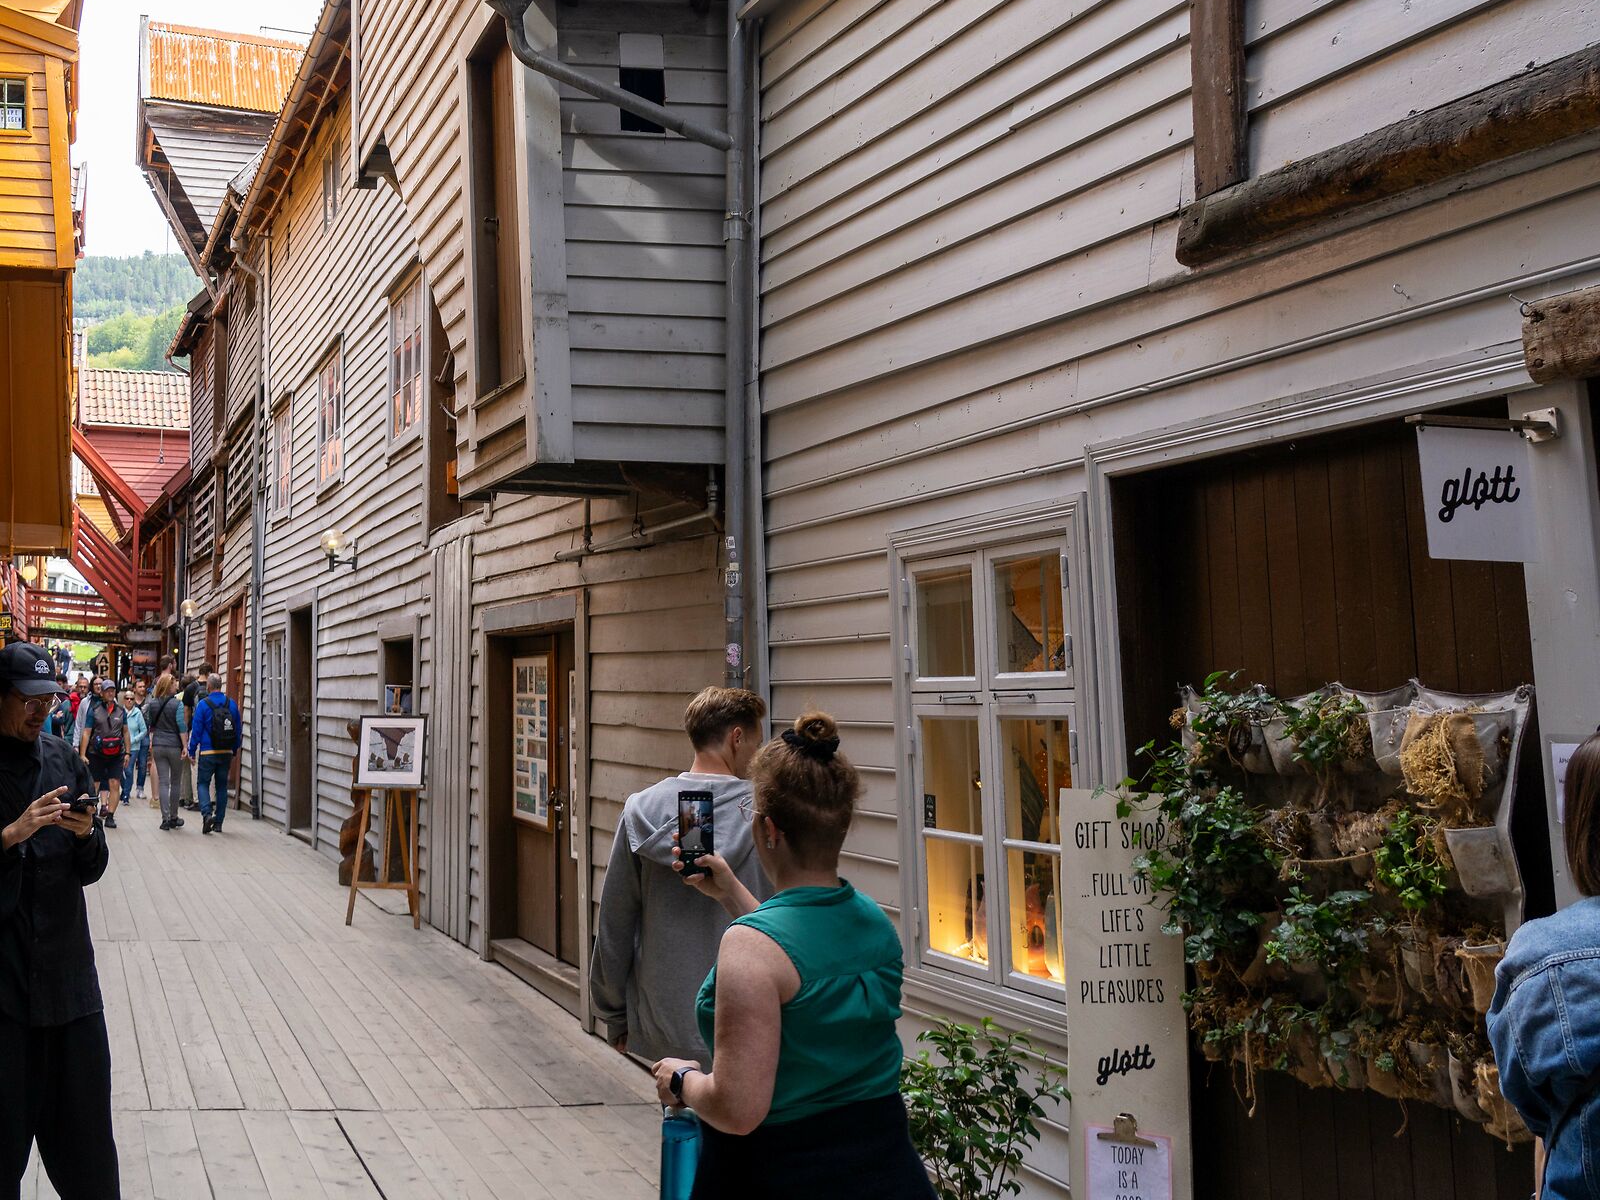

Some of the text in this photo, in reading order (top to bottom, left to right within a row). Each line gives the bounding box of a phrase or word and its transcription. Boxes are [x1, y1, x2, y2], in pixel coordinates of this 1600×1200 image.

[1438, 465, 1520, 523] gløtt
[1075, 821, 1165, 850] GIFT SHOP
[1101, 908, 1144, 932] LIFE'S
[1099, 943, 1151, 968] LITTLE
[1080, 978, 1165, 1004] PLEASURES
[1097, 1043, 1155, 1086] gløtt
[1110, 1145, 1144, 1165] TODAY
[1118, 1170, 1139, 1189] IS A
